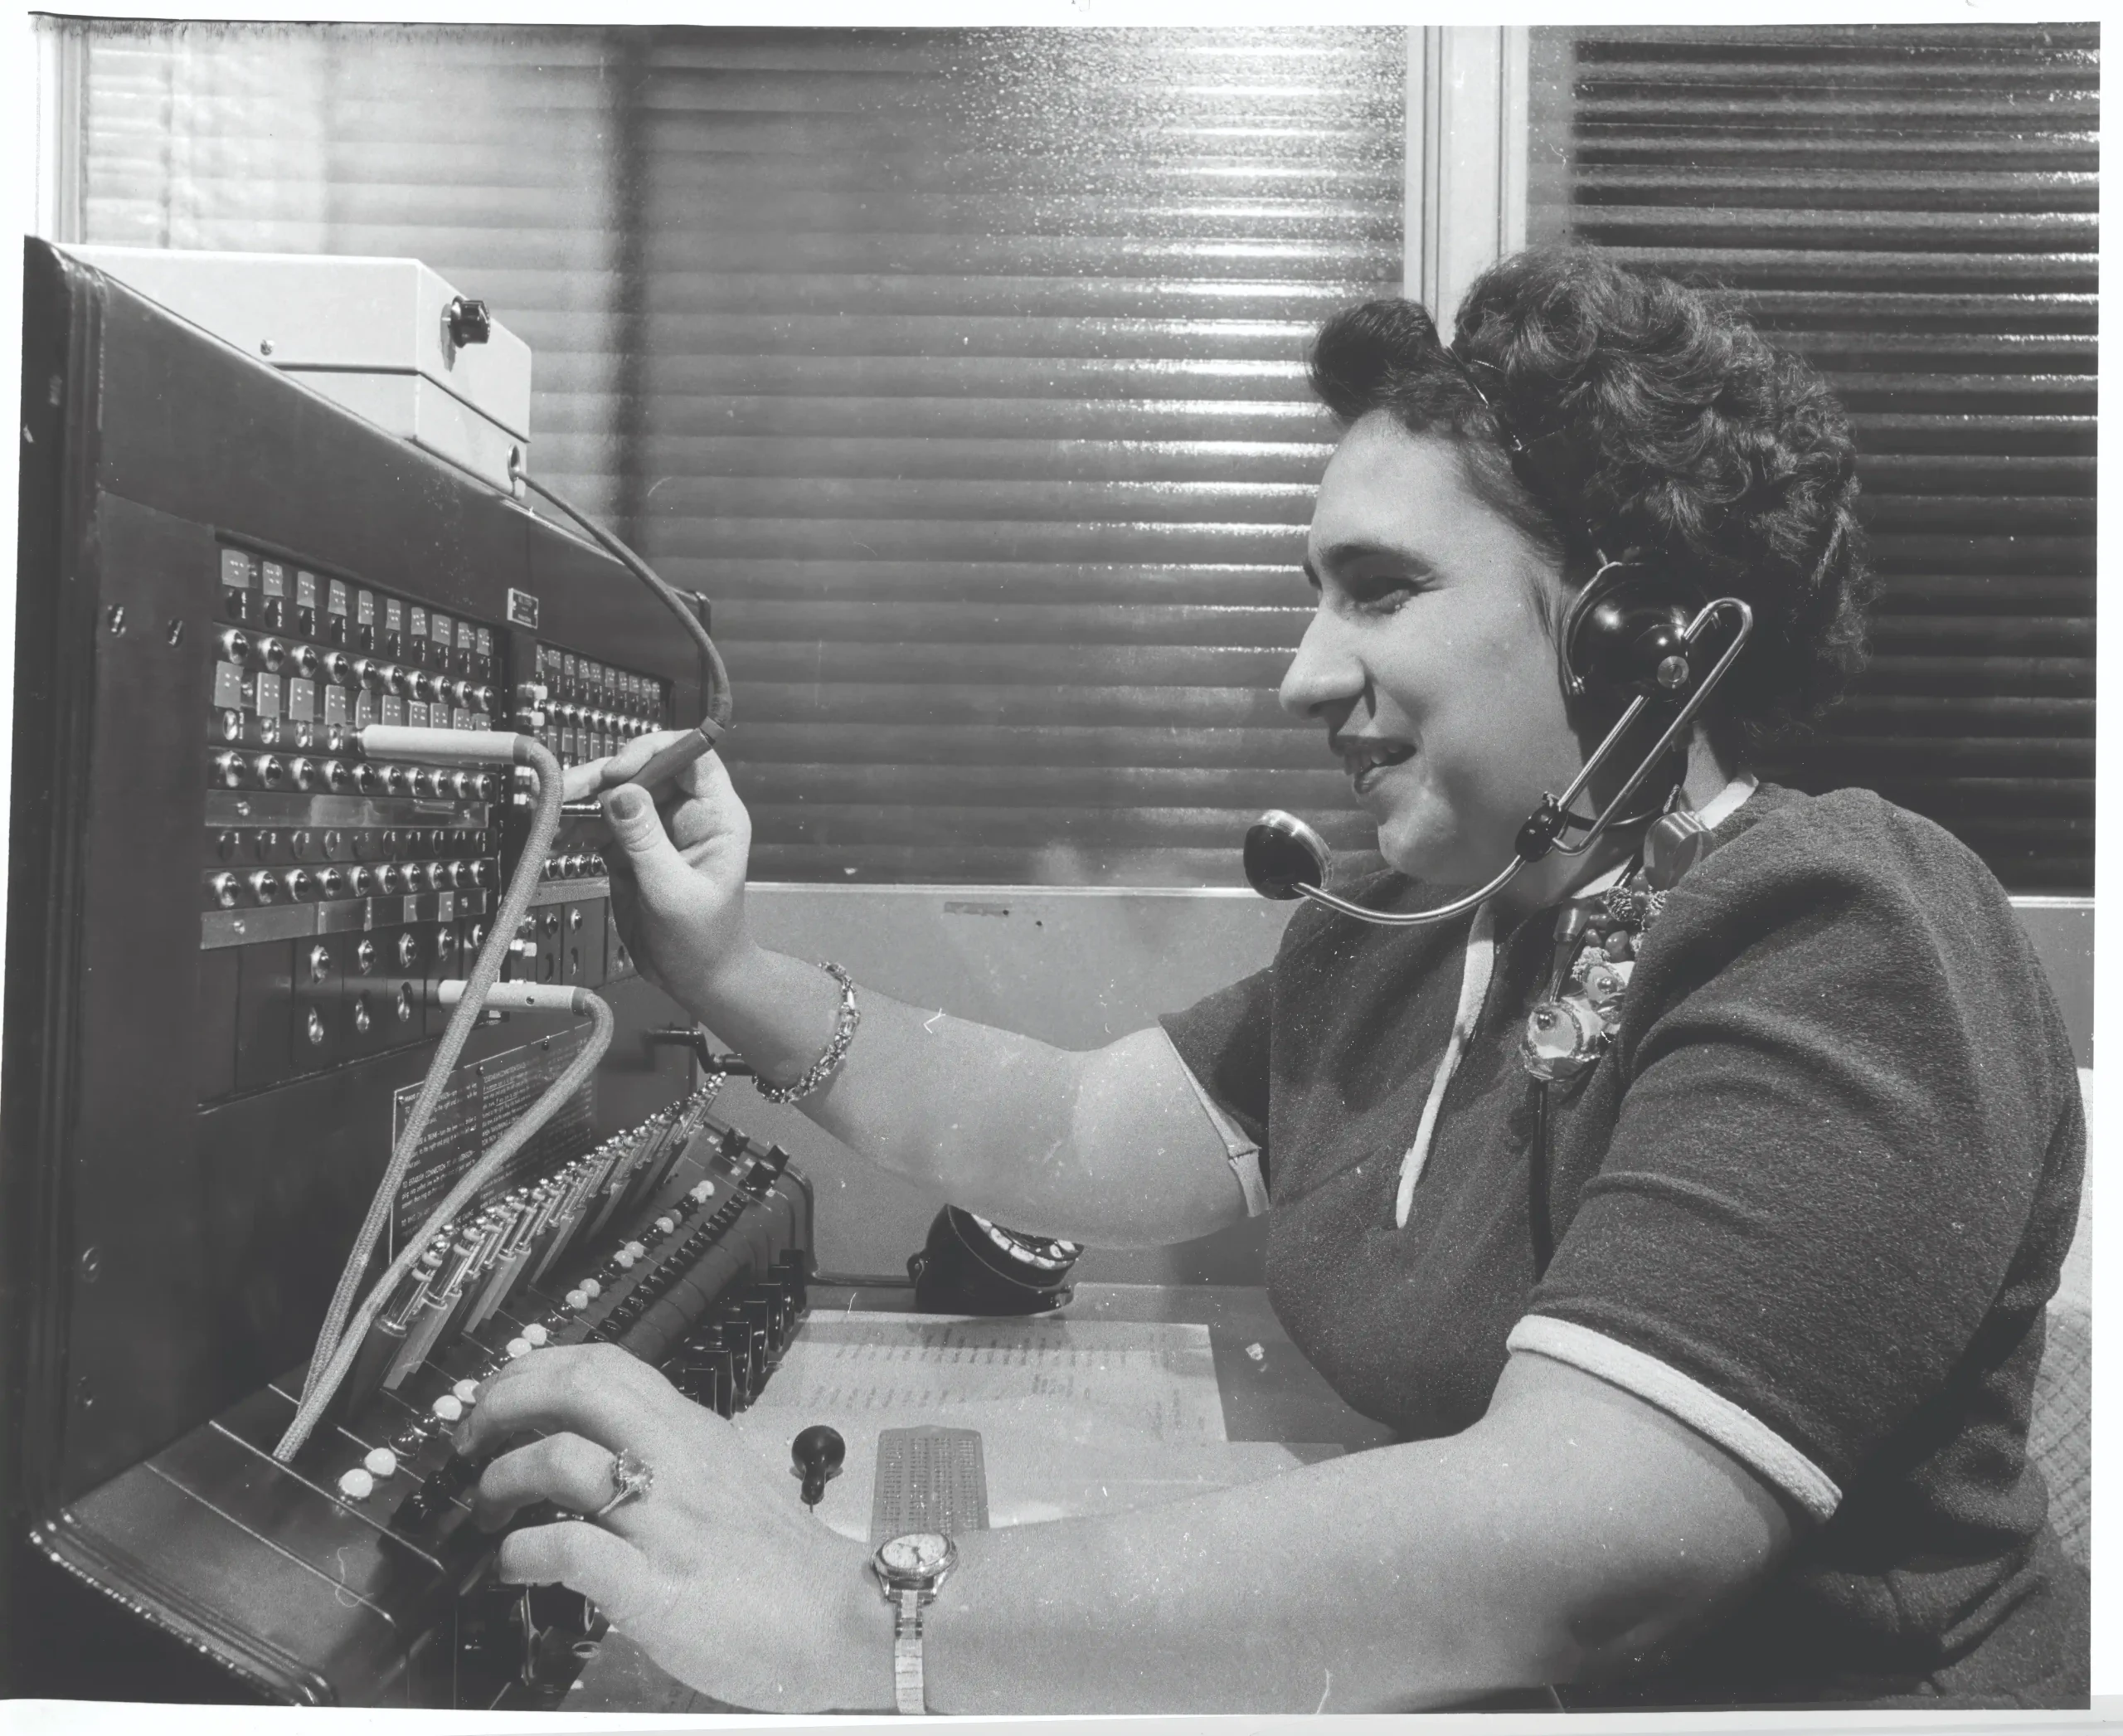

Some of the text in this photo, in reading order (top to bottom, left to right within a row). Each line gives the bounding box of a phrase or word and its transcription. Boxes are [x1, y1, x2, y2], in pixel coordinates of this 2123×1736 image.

[234, 832, 240, 844] 1
[270, 832, 276, 844] 2
[304, 832, 310, 844] 3
[336, 832, 341, 844] 4
